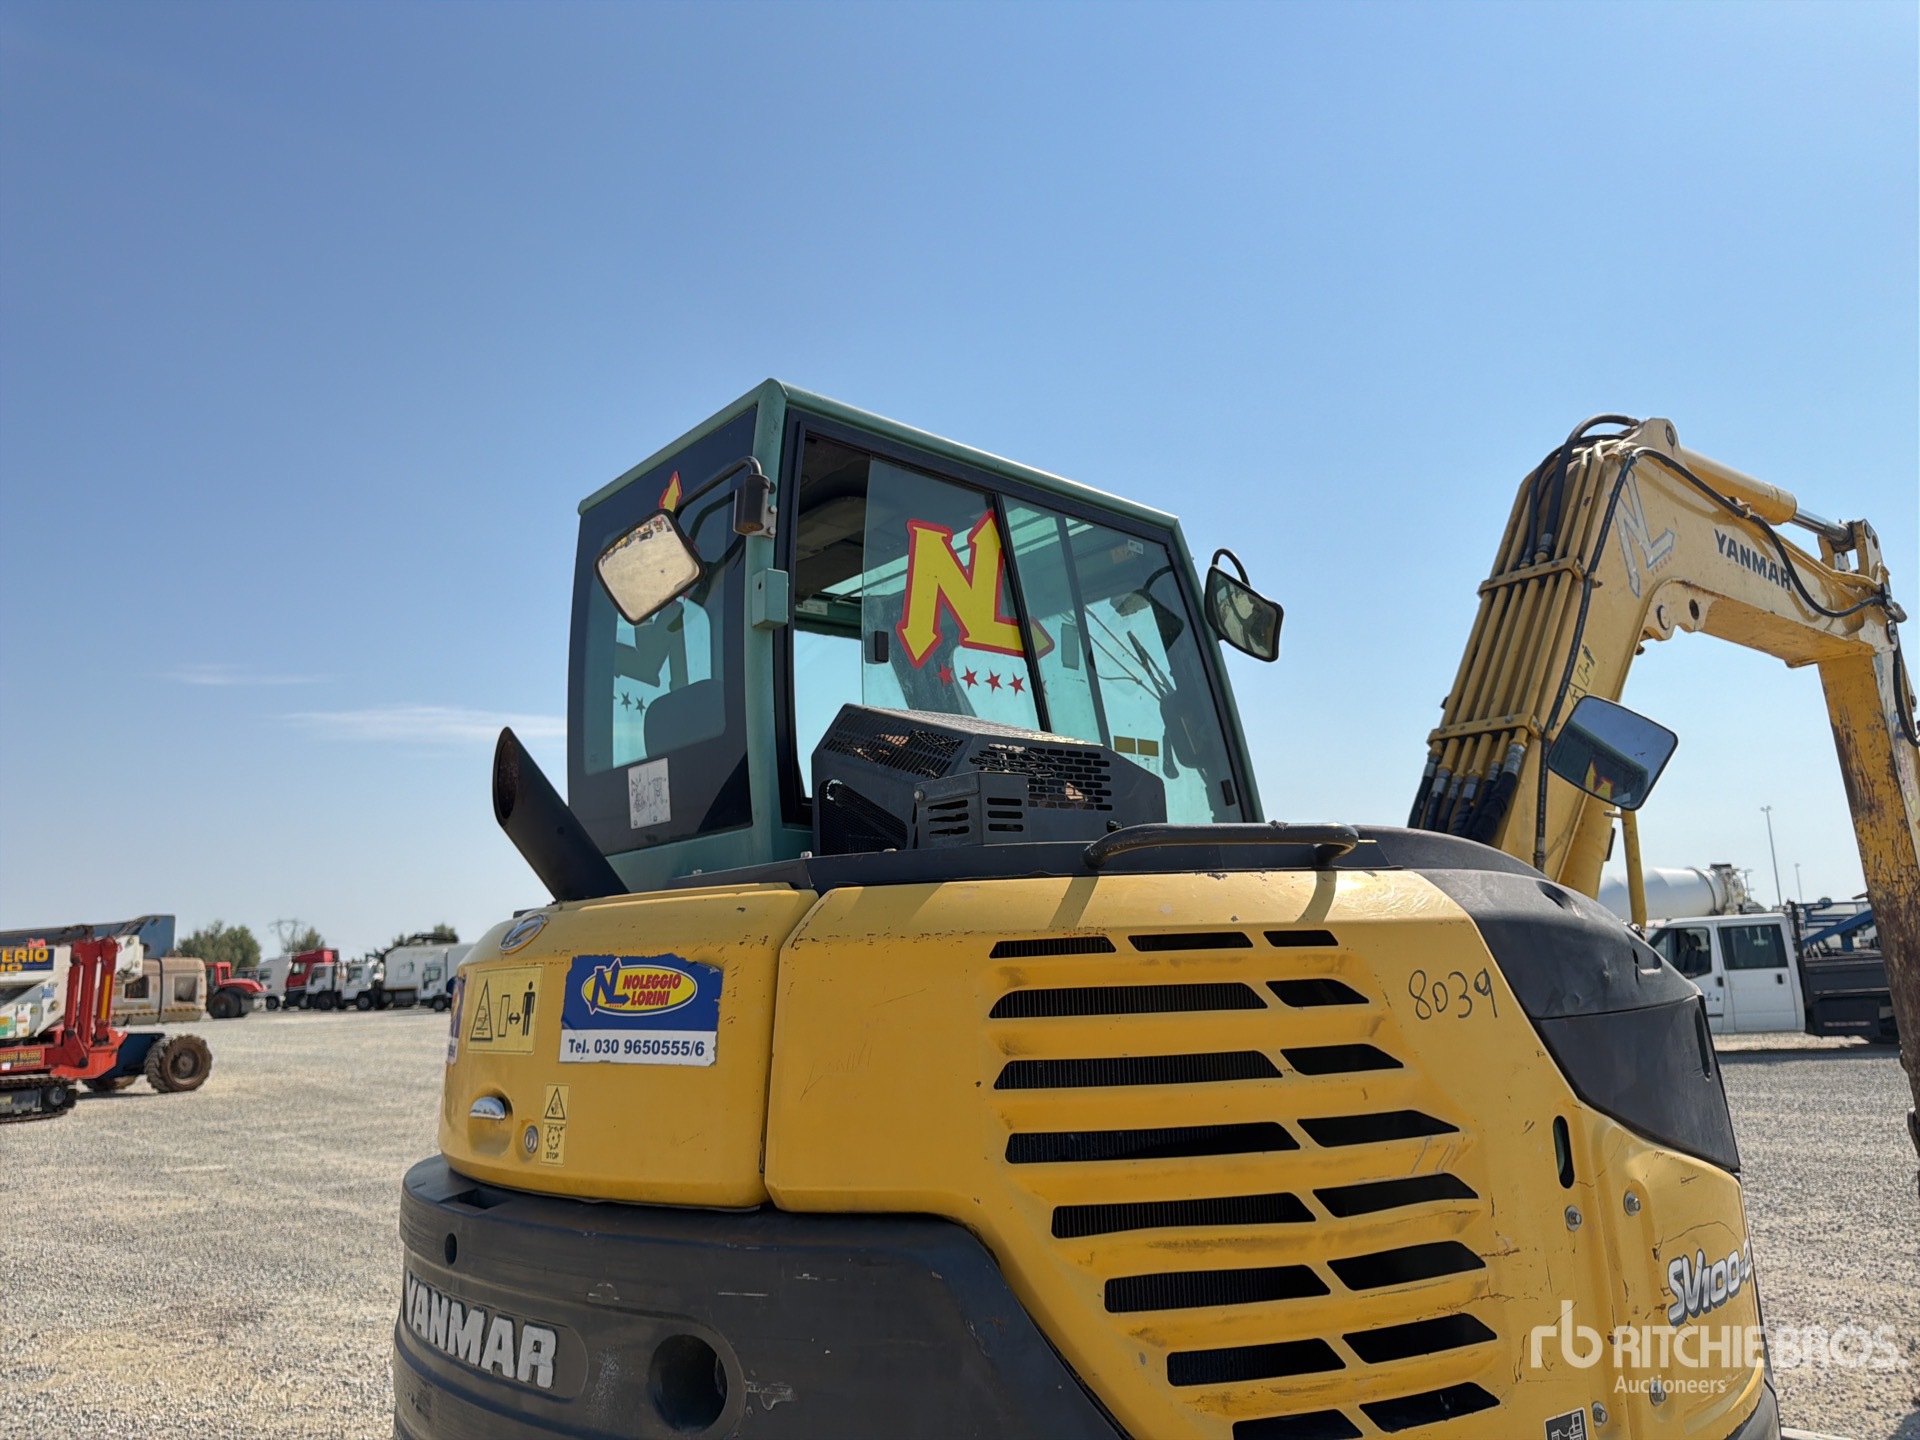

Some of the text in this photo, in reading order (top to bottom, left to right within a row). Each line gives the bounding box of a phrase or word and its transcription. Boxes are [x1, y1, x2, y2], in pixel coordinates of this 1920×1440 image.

[1713, 528, 1791, 592] YANMAR
[0, 948, 49, 963] ERIO
[622, 973, 682, 990] NOLEGGIO
[630, 990, 671, 1006] LORINI
[1408, 967, 1498, 1020] 8039
[568, 1038, 705, 1057] Tel. 030 9650555/6
[546, 1151, 559, 1160] STOP
[405, 1270, 558, 1389] YANMAR
